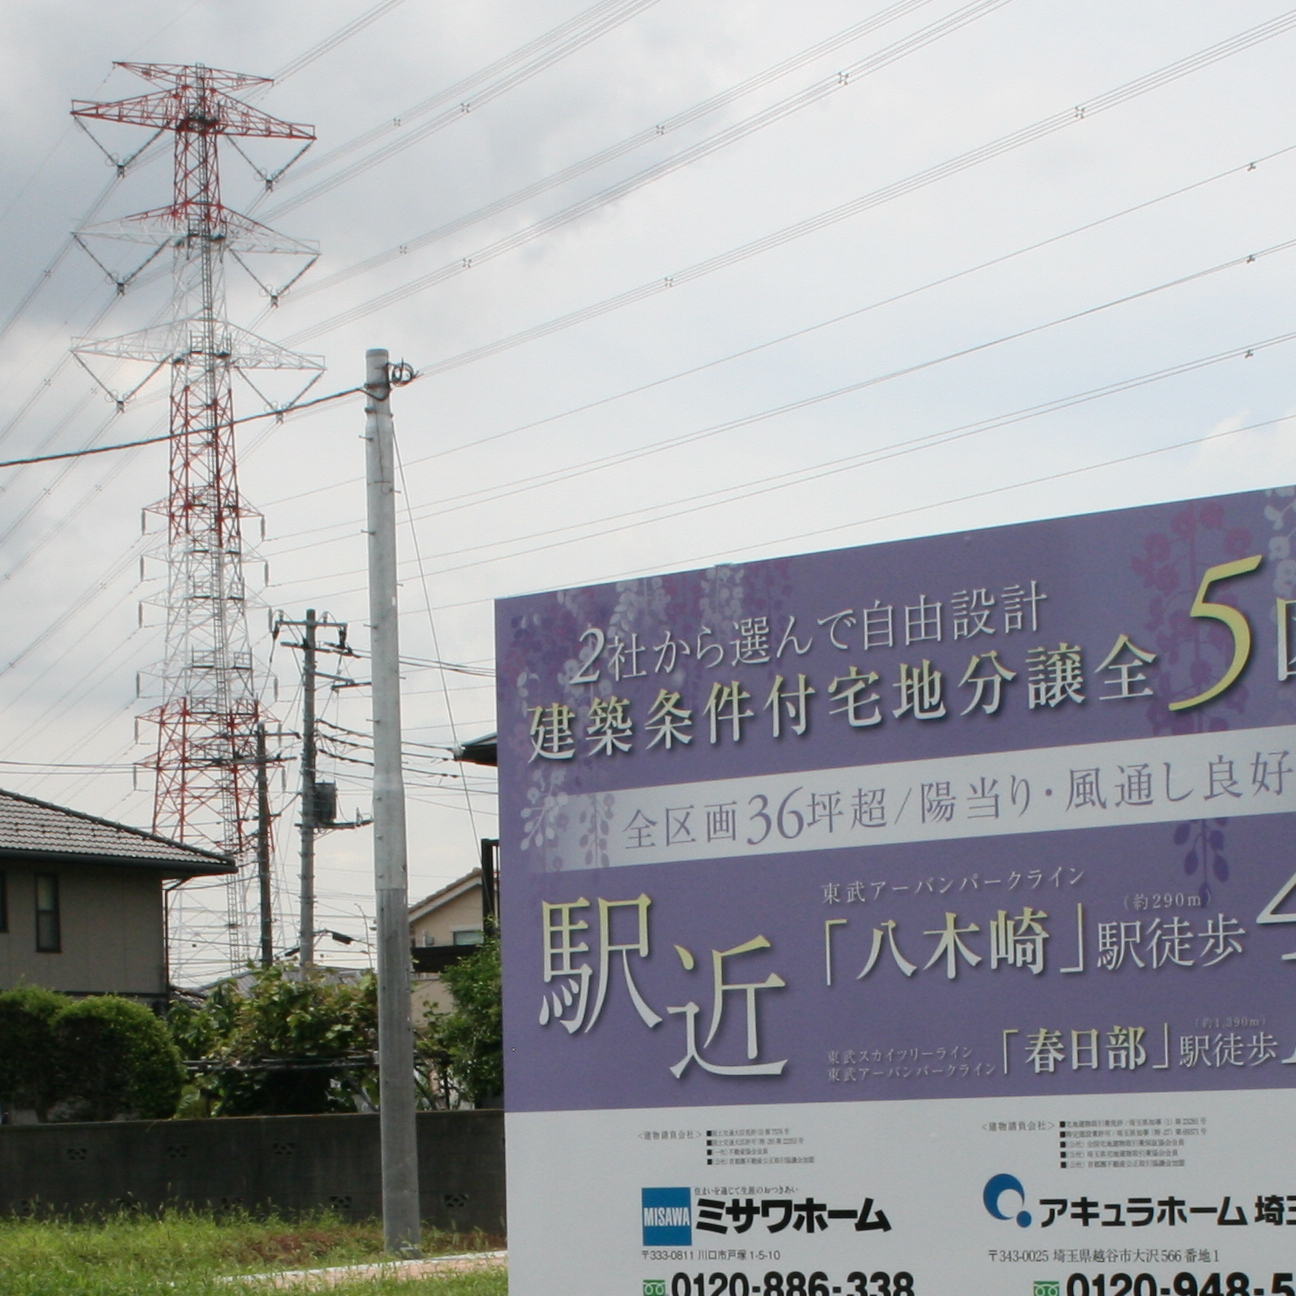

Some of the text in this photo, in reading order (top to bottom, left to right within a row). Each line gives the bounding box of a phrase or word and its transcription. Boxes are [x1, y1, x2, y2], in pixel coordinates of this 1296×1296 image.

[569, 580, 1049, 686] 2社から選んで自由設計
[821, 866, 1085, 905] 東武アーバンパークライン
[537, 892, 789, 1080] 駅近
[827, 1046, 973, 1066] 東武スカイツリーライン
[827, 1062, 996, 1083] 東武アーバンパークライン
[643, 1206, 691, 1227] MISAWA
[695, 1197, 893, 1235] ミサワホーム
[1039, 1196, 1248, 1228] アキュラホーム
